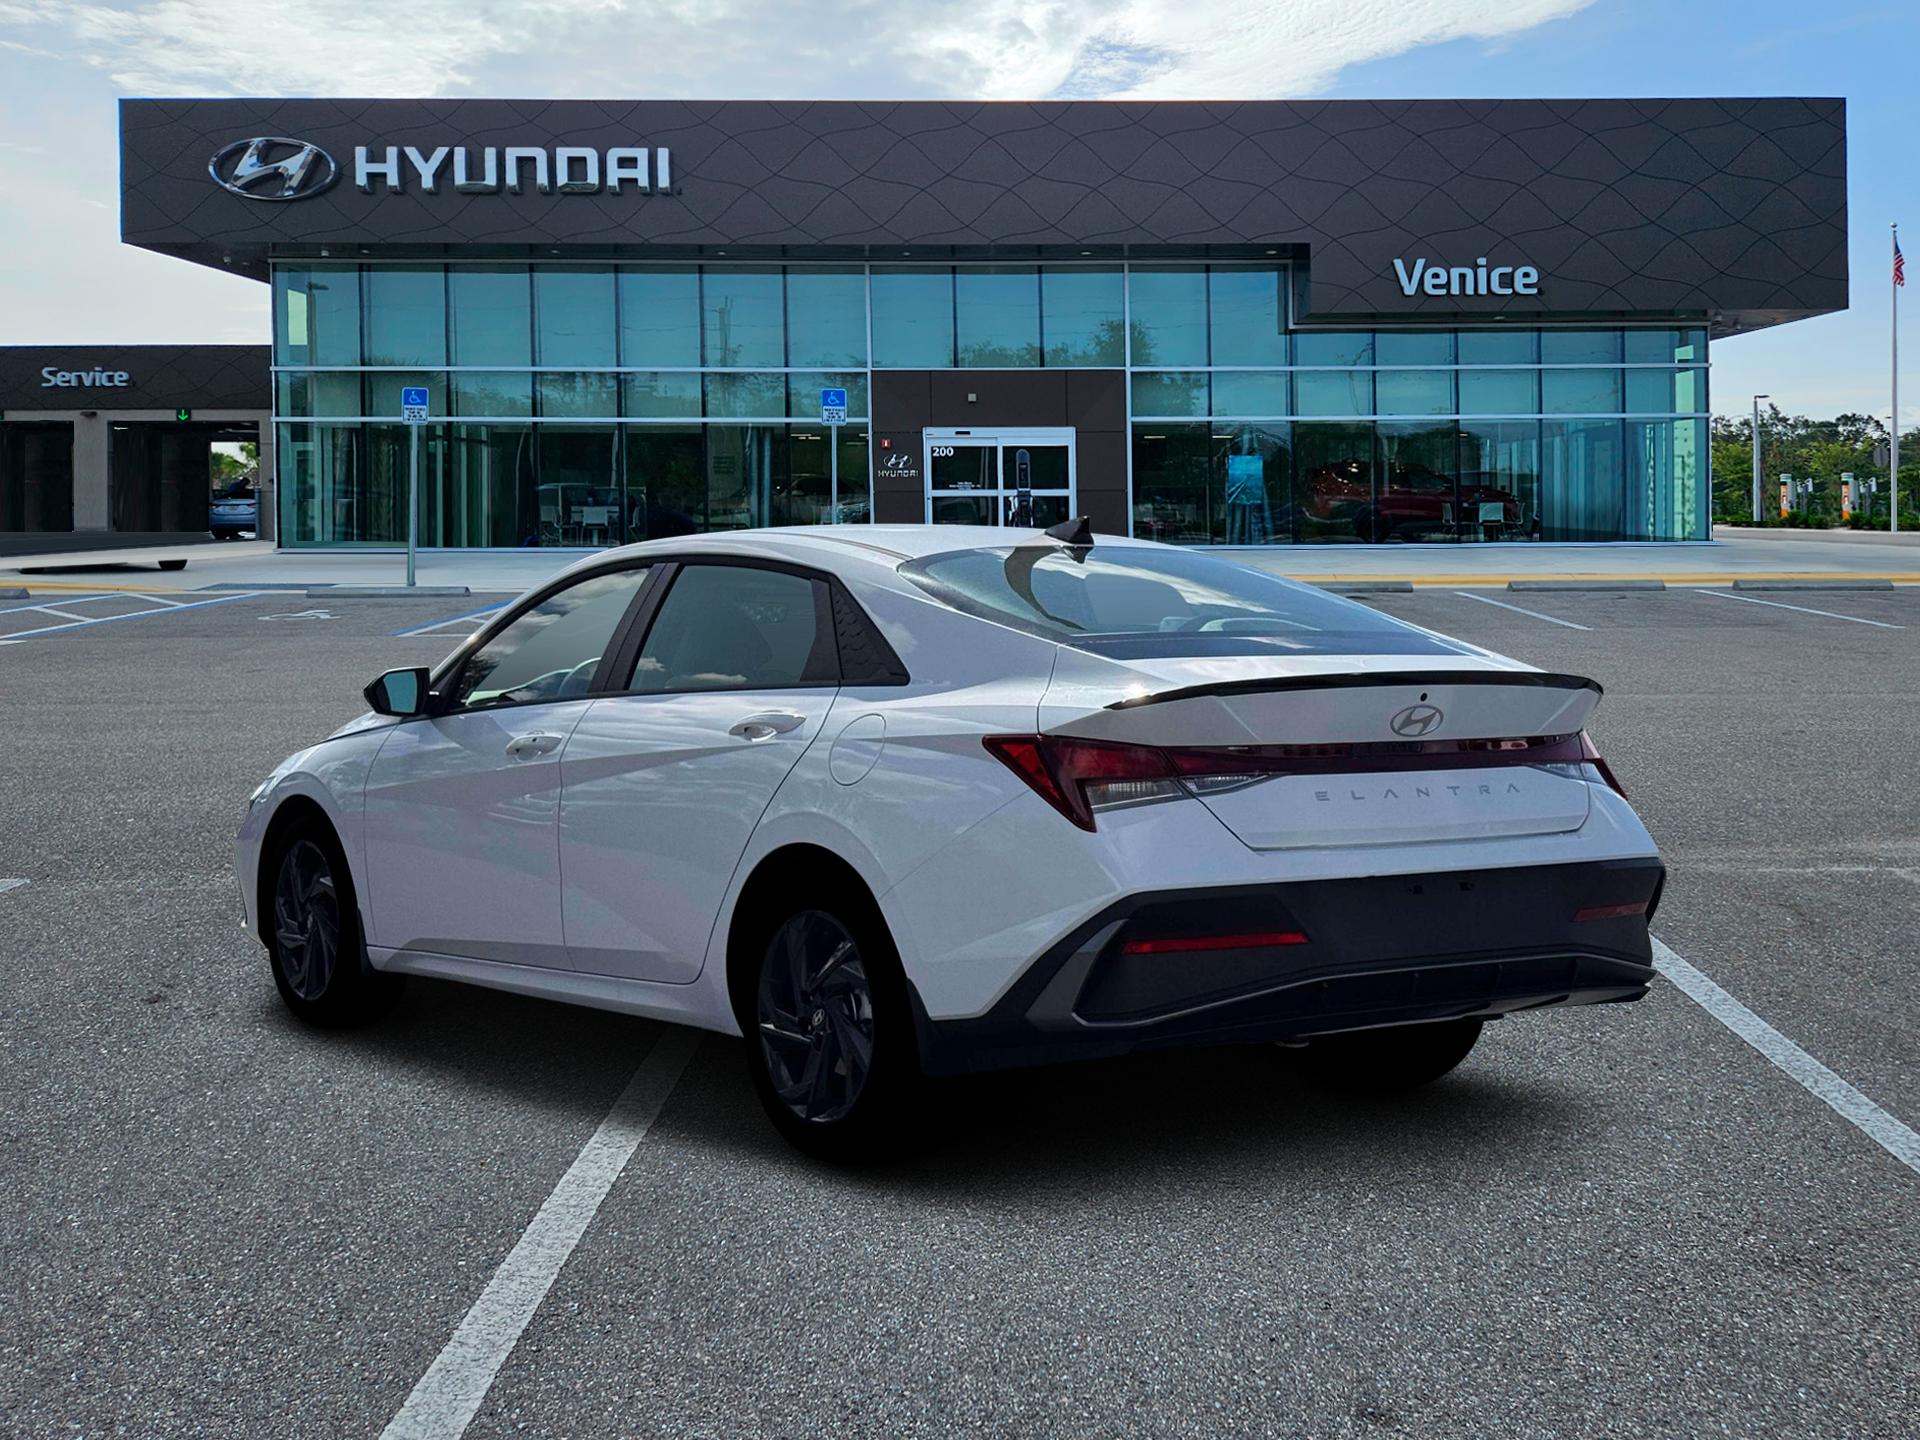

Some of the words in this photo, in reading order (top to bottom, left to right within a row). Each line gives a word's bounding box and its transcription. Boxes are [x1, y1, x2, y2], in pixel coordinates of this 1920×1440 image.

[354, 146, 671, 193] HYUNDAI
[1393, 256, 1539, 296] Venice
[41, 366, 130, 387] Service
[932, 447, 954, 457] 200
[878, 470, 919, 478] HYUNDAI
[1315, 783, 1521, 801] ELANTRA
